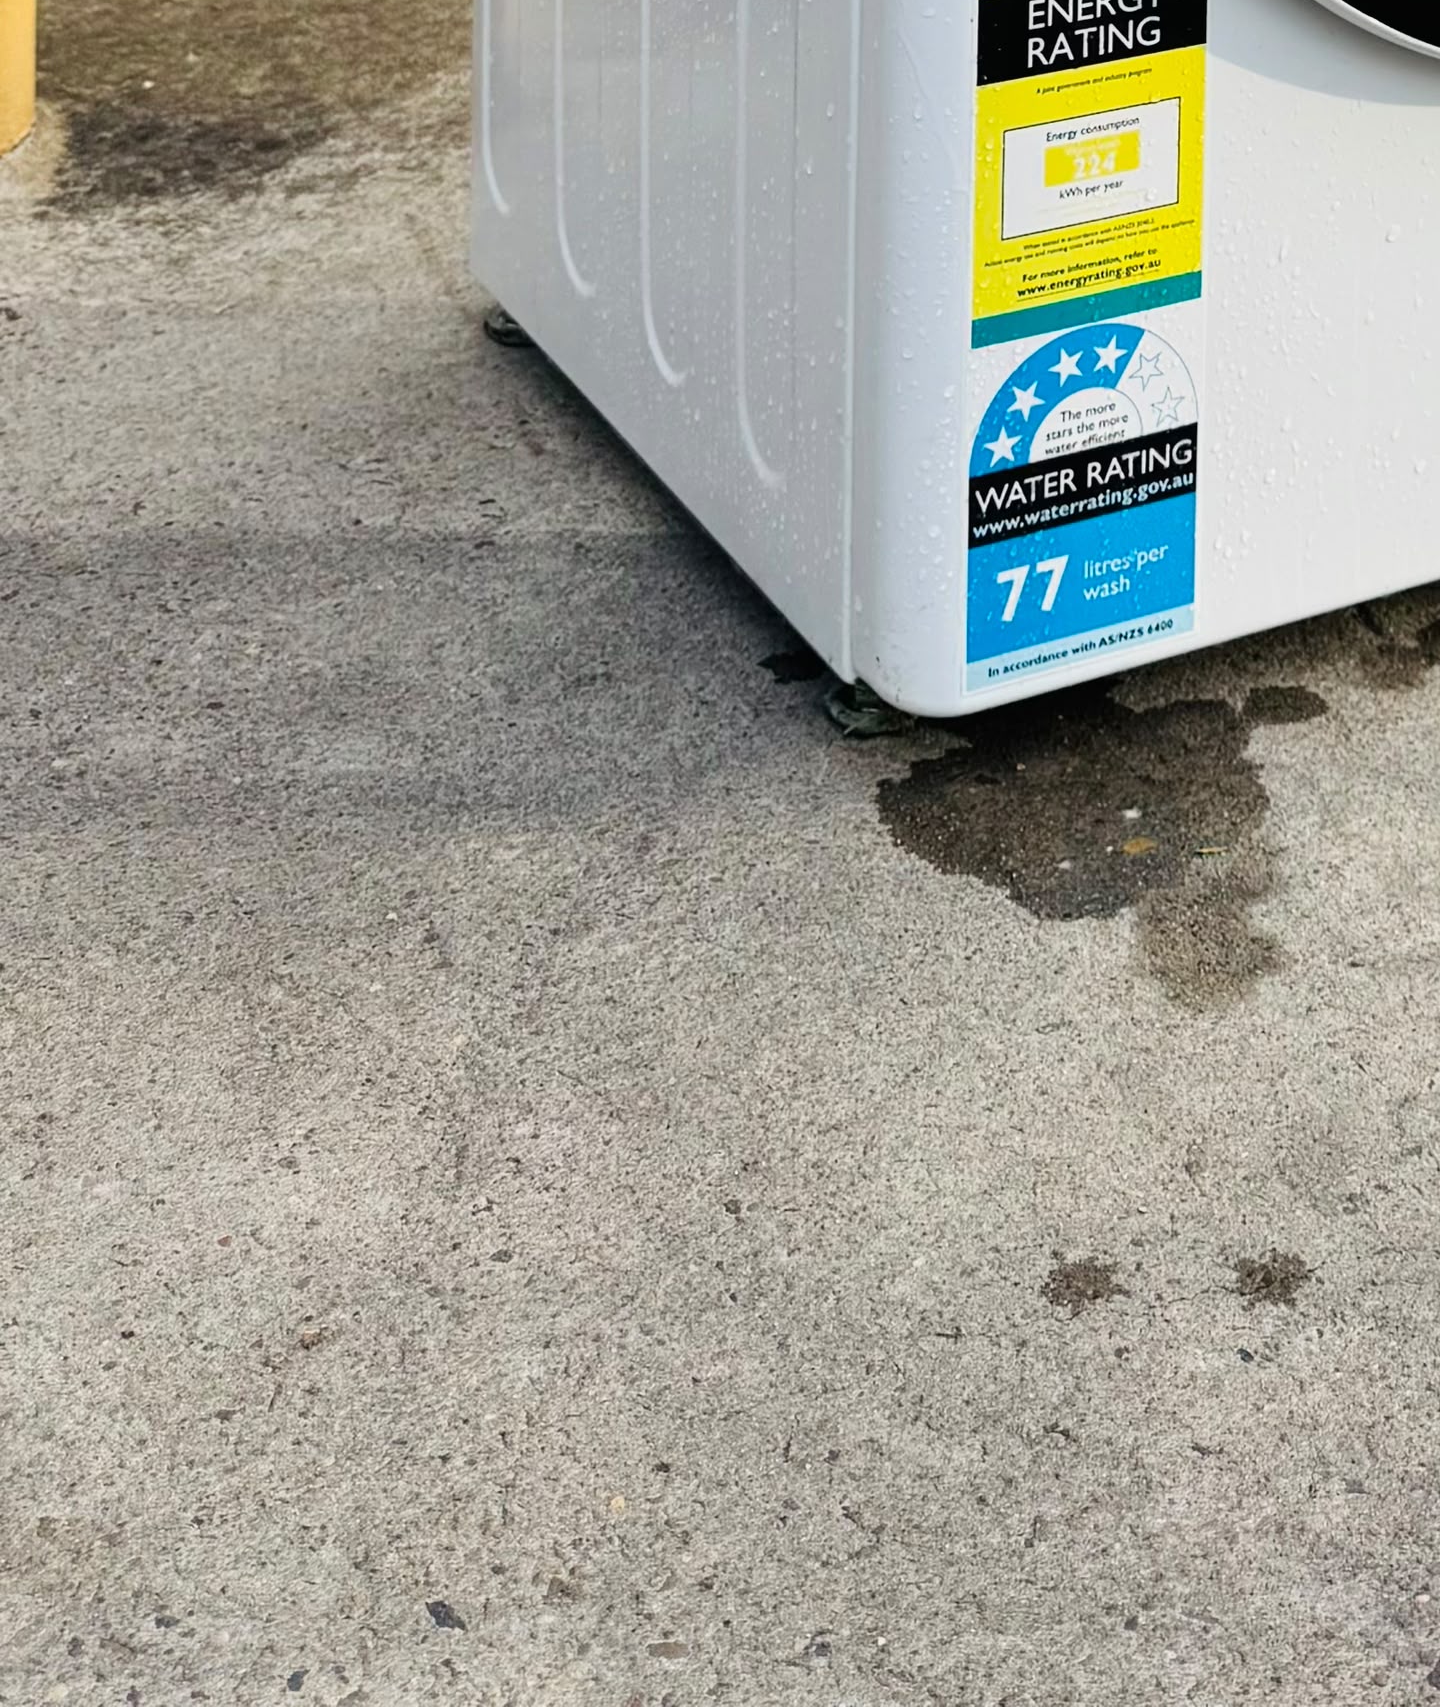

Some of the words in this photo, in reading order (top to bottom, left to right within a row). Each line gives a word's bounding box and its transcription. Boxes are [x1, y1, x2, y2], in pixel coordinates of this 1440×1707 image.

[1027, 15, 1161, 69] RATING
[1046, 130, 1078, 142] Energy
[1080, 117, 1140, 137] consumption
[1059, 186, 1083, 199] kWh
[1085, 184, 1101, 197] per
[1104, 180, 1124, 193] year
[1016, 258, 1162, 298] www.energyrating.gov.au
[1022, 273, 1038, 283] For
[1039, 267, 1066, 280] more
[1123, 249, 1146, 261] refer
[1147, 247, 1158, 255] to
[1046, 427, 1073, 442] stars
[1076, 421, 1095, 435] the
[1098, 414, 1129, 428] more
[1060, 409, 1082, 423] The
[1085, 402, 1116, 417] more
[1045, 440, 1077, 455] water
[1081, 429, 1125, 447] efficient
[974, 468, 1077, 513] WATER
[1086, 439, 1193, 488] RATING
[972, 472, 1194, 538] www.waterrating.gov.au
[996, 554, 1069, 622] 77
[1083, 557, 1130, 579] litres
[1136, 544, 1169, 571] per
[1082, 574, 1131, 601] wash
[988, 666, 1000, 678] In
[1002, 649, 1069, 674] accordance
[1071, 642, 1097, 656] with
[1098, 626, 1145, 648] AS/NZS
[1146, 618, 1174, 635] 6400
